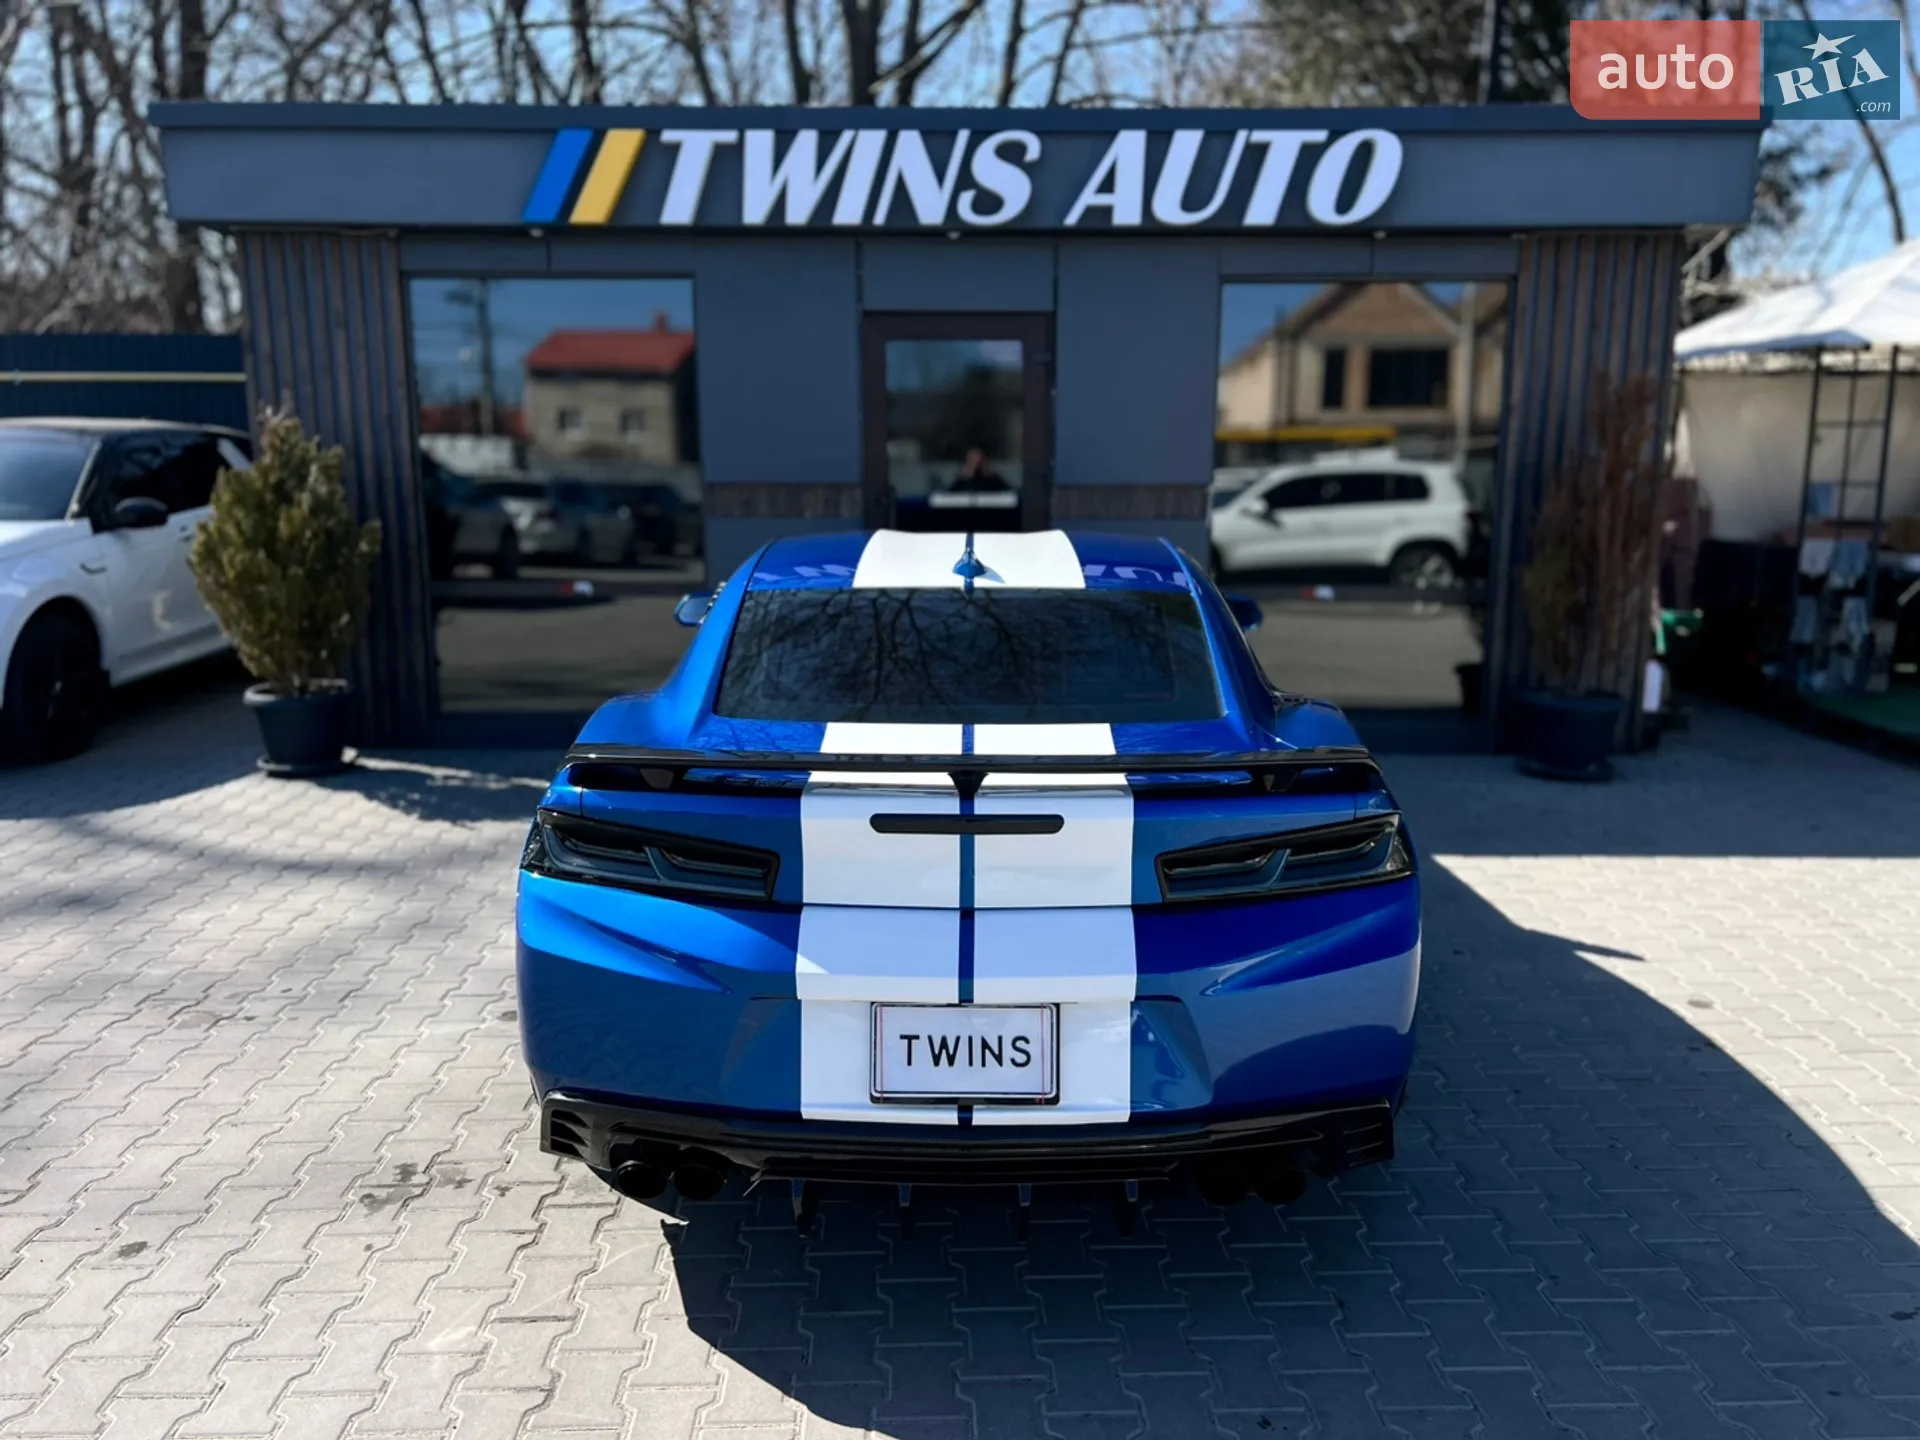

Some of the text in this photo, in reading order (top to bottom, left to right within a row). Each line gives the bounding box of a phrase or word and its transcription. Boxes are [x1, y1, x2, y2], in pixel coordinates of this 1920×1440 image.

[658, 128, 1403, 227] TWINS AUTO
[899, 1034, 1032, 1068] TWINS
